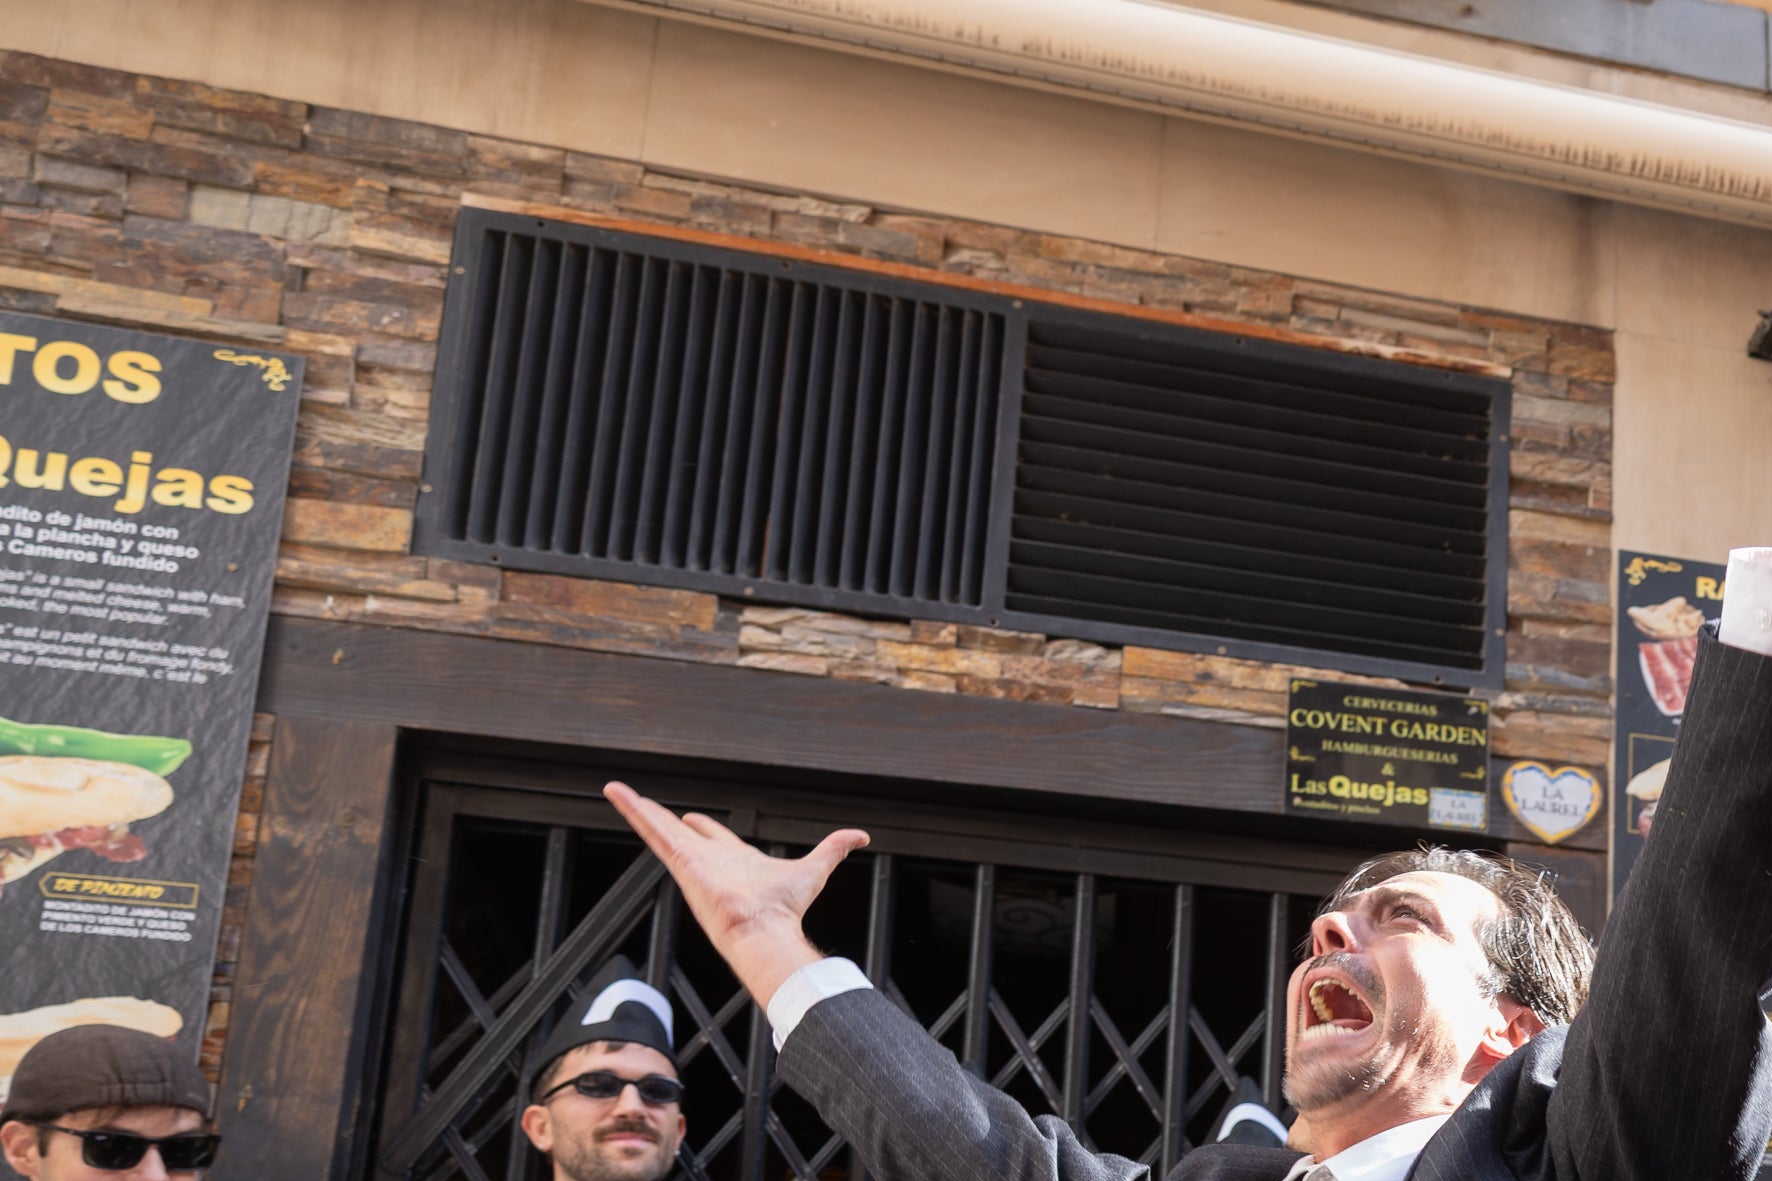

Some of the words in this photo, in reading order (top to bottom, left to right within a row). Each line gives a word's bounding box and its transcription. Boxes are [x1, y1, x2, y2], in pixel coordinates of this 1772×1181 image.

[0, 434, 255, 515] uejas
[0, 505, 42, 523] dito
[45, 510, 73, 527] de
[73, 512, 138, 535] jamón
[141, 524, 180, 541] con
[7, 538, 99, 564] Cameros
[101, 549, 179, 574] fundido
[14, 522, 34, 539] la
[36, 526, 117, 549] plancha
[120, 538, 135, 554] y
[137, 540, 200, 559] queso
[105, 582, 176, 599] sandwich
[1343, 695, 1438, 717] CERVECERIAS
[1290, 708, 1388, 735] COVENT
[1390, 719, 1487, 747] GARDEN
[1321, 739, 1459, 765] HAMBURGUESERIAS
[1381, 762, 1396, 776] &
[1291, 773, 1328, 796] Las
[1328, 774, 1429, 807] Quejas
[1542, 786, 1564, 801] LA
